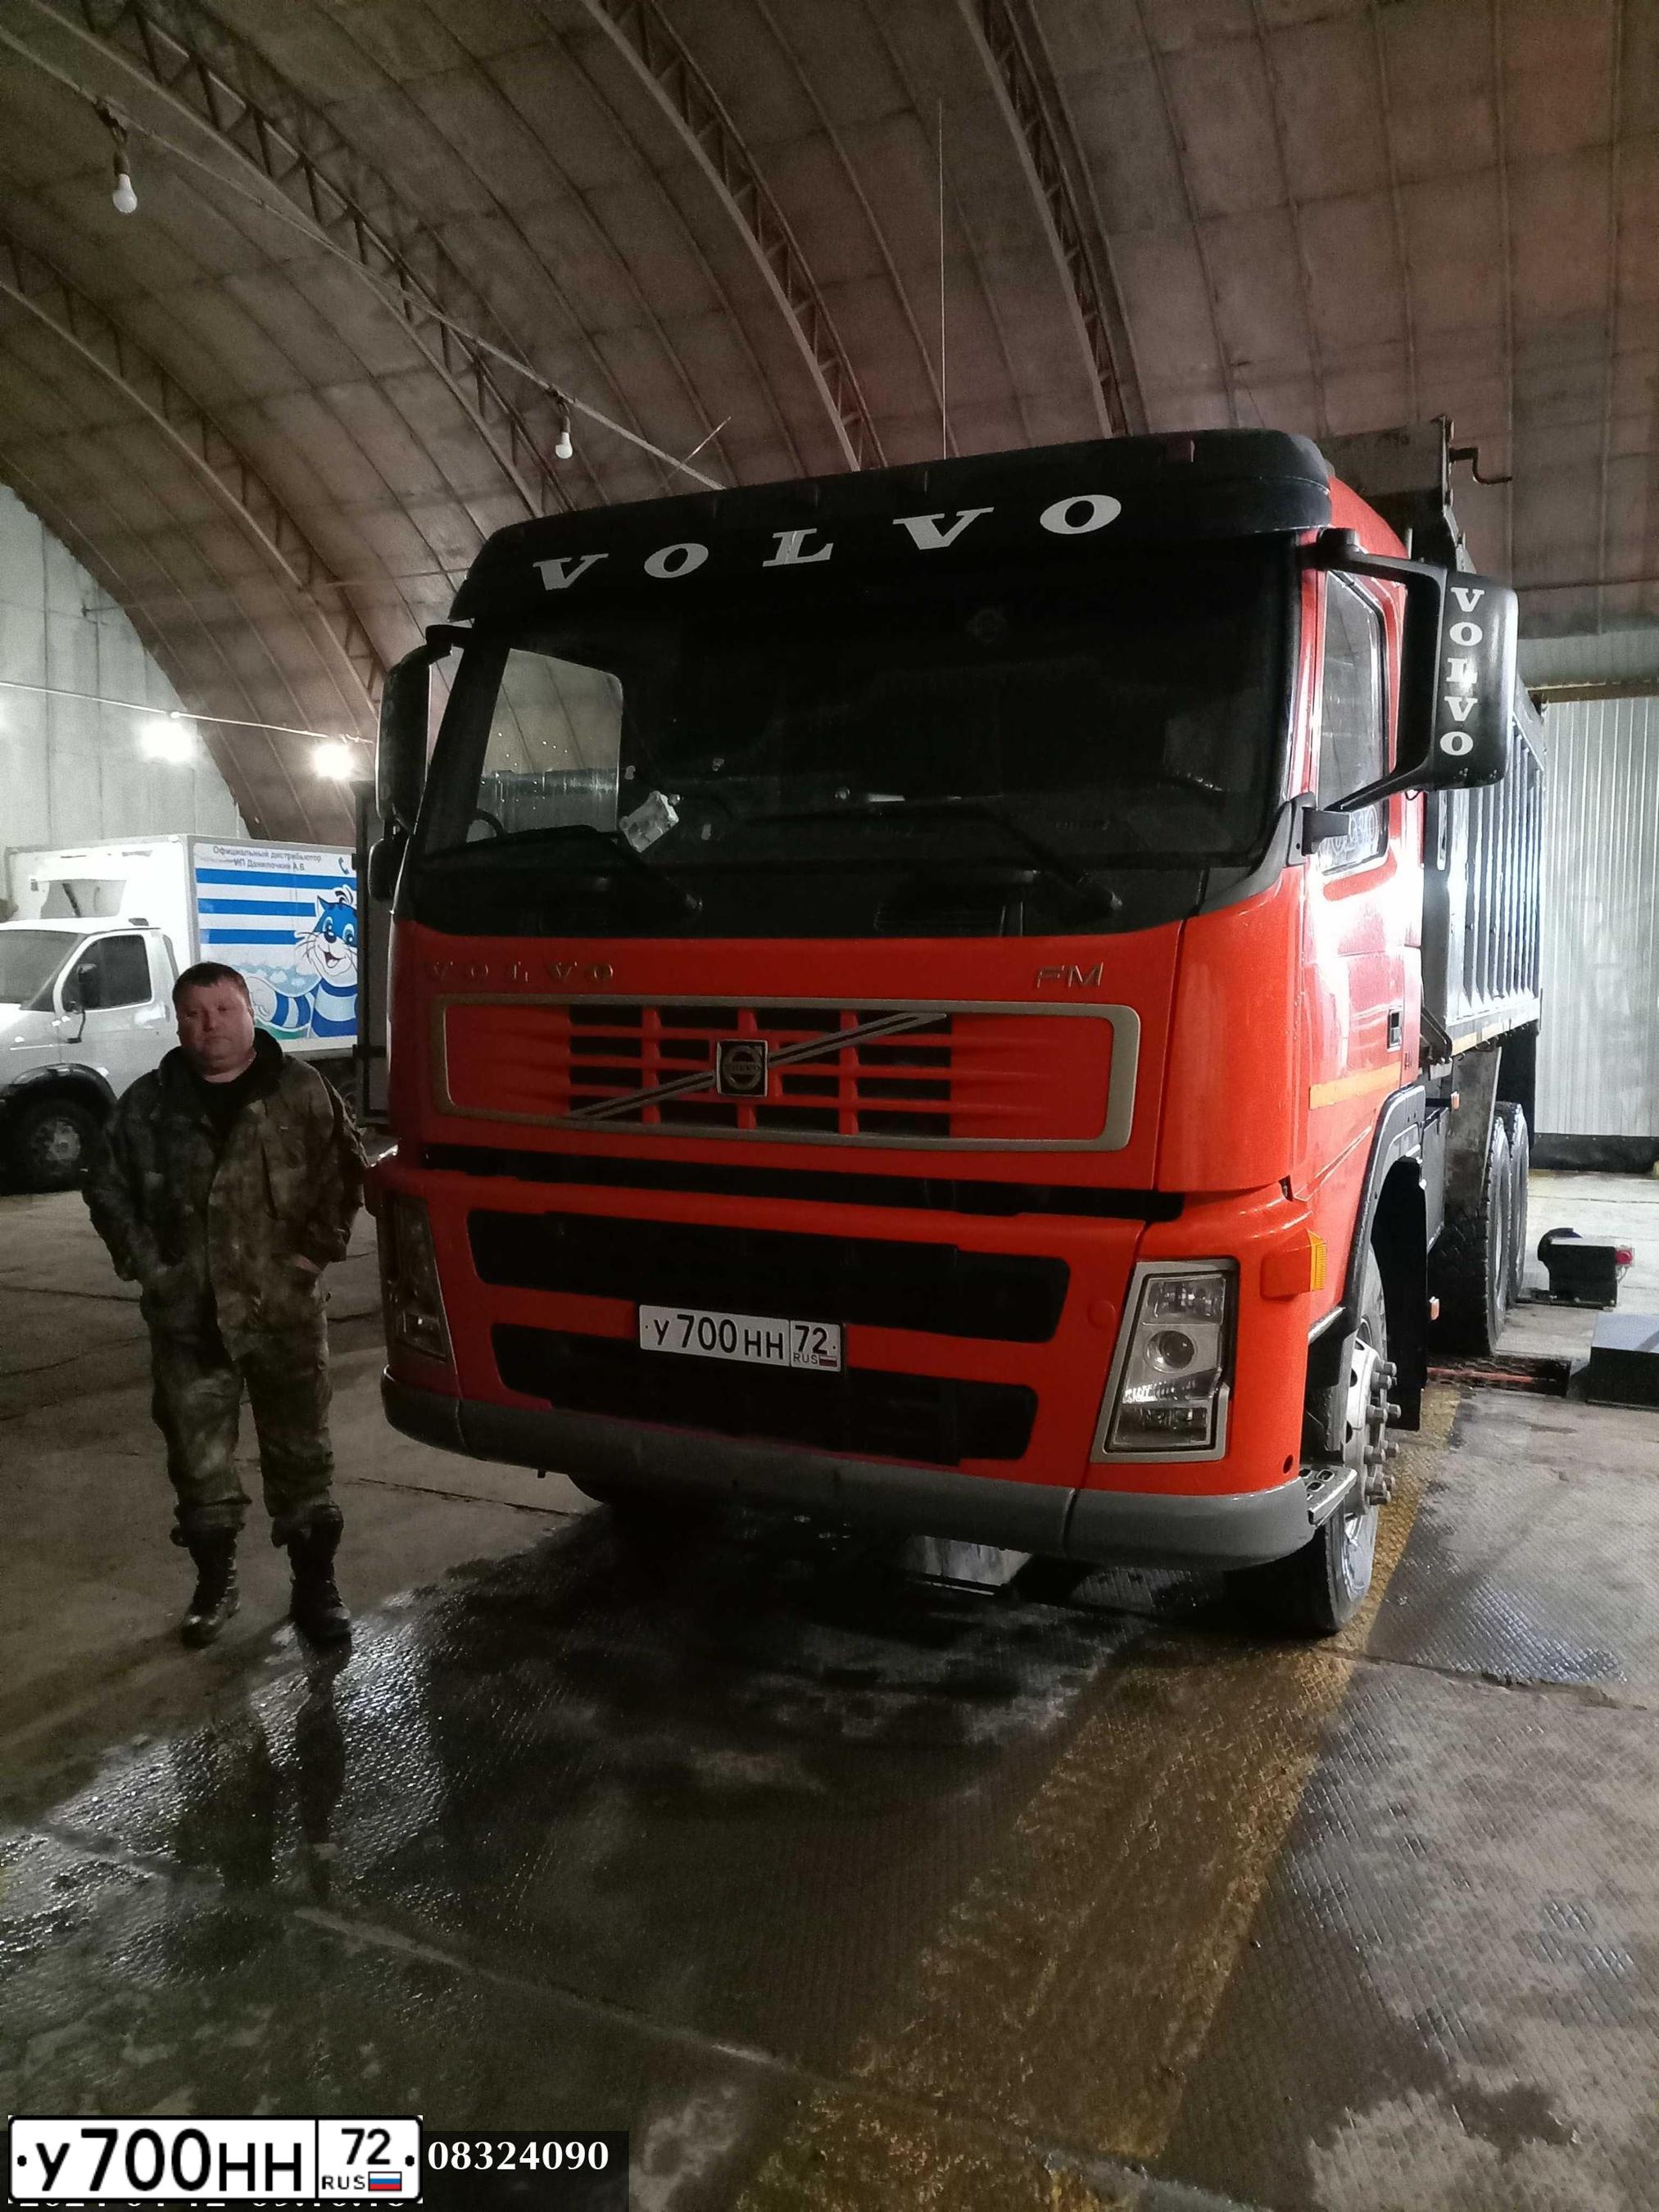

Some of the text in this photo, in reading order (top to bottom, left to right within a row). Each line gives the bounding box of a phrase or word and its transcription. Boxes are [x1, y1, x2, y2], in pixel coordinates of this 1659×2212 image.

[533, 494, 1122, 590] VOLVO
[1439, 587, 1485, 756] VOLVO
[213, 845, 322, 863] Официальный дистрибьютор
[1036, 962, 1104, 988] FM
[794, 1325, 828, 1355] 72
[793, 1351, 818, 1365] RUS
